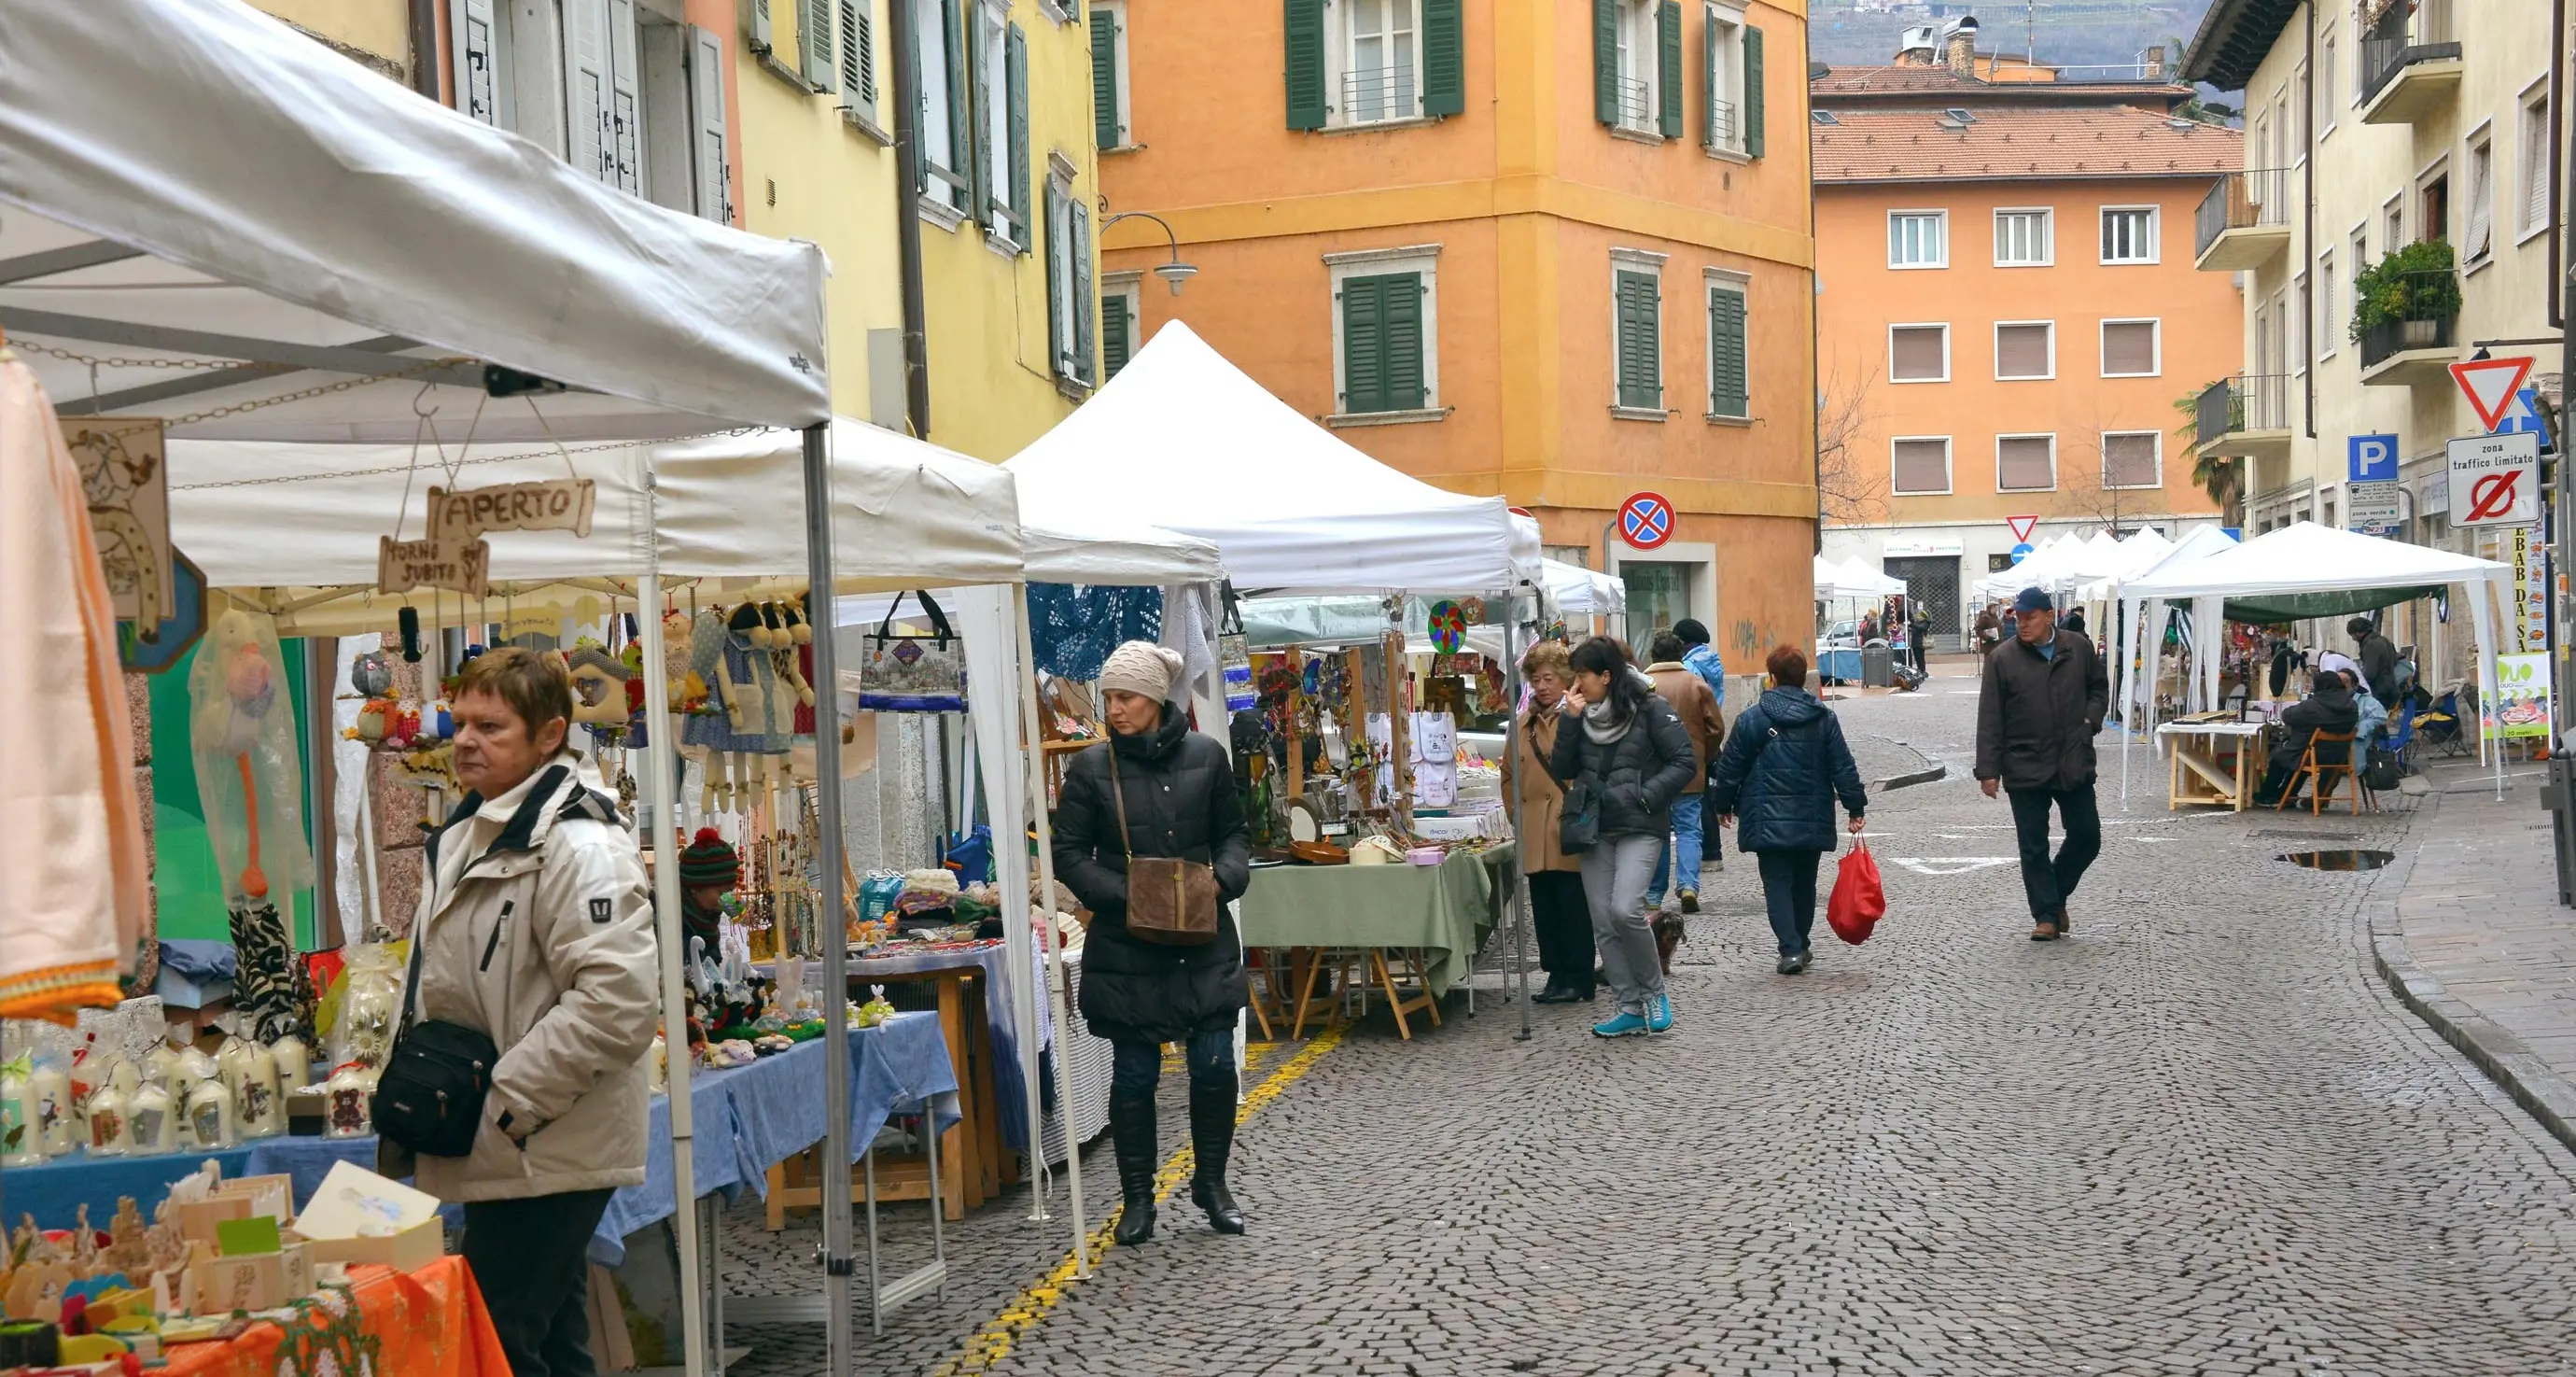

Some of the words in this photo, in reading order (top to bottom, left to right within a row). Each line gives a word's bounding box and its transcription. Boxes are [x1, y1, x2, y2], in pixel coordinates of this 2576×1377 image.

[2482, 444, 2503, 454] zona
[2359, 442, 2387, 476] P
[2453, 458, 2490, 470] traffico
[2495, 454, 2534, 466] limitato
[445, 488, 570, 526] APERTO
[387, 542, 439, 560] TORNO
[401, 563, 457, 582] SUBITO
[2515, 588, 2526, 616] DA
